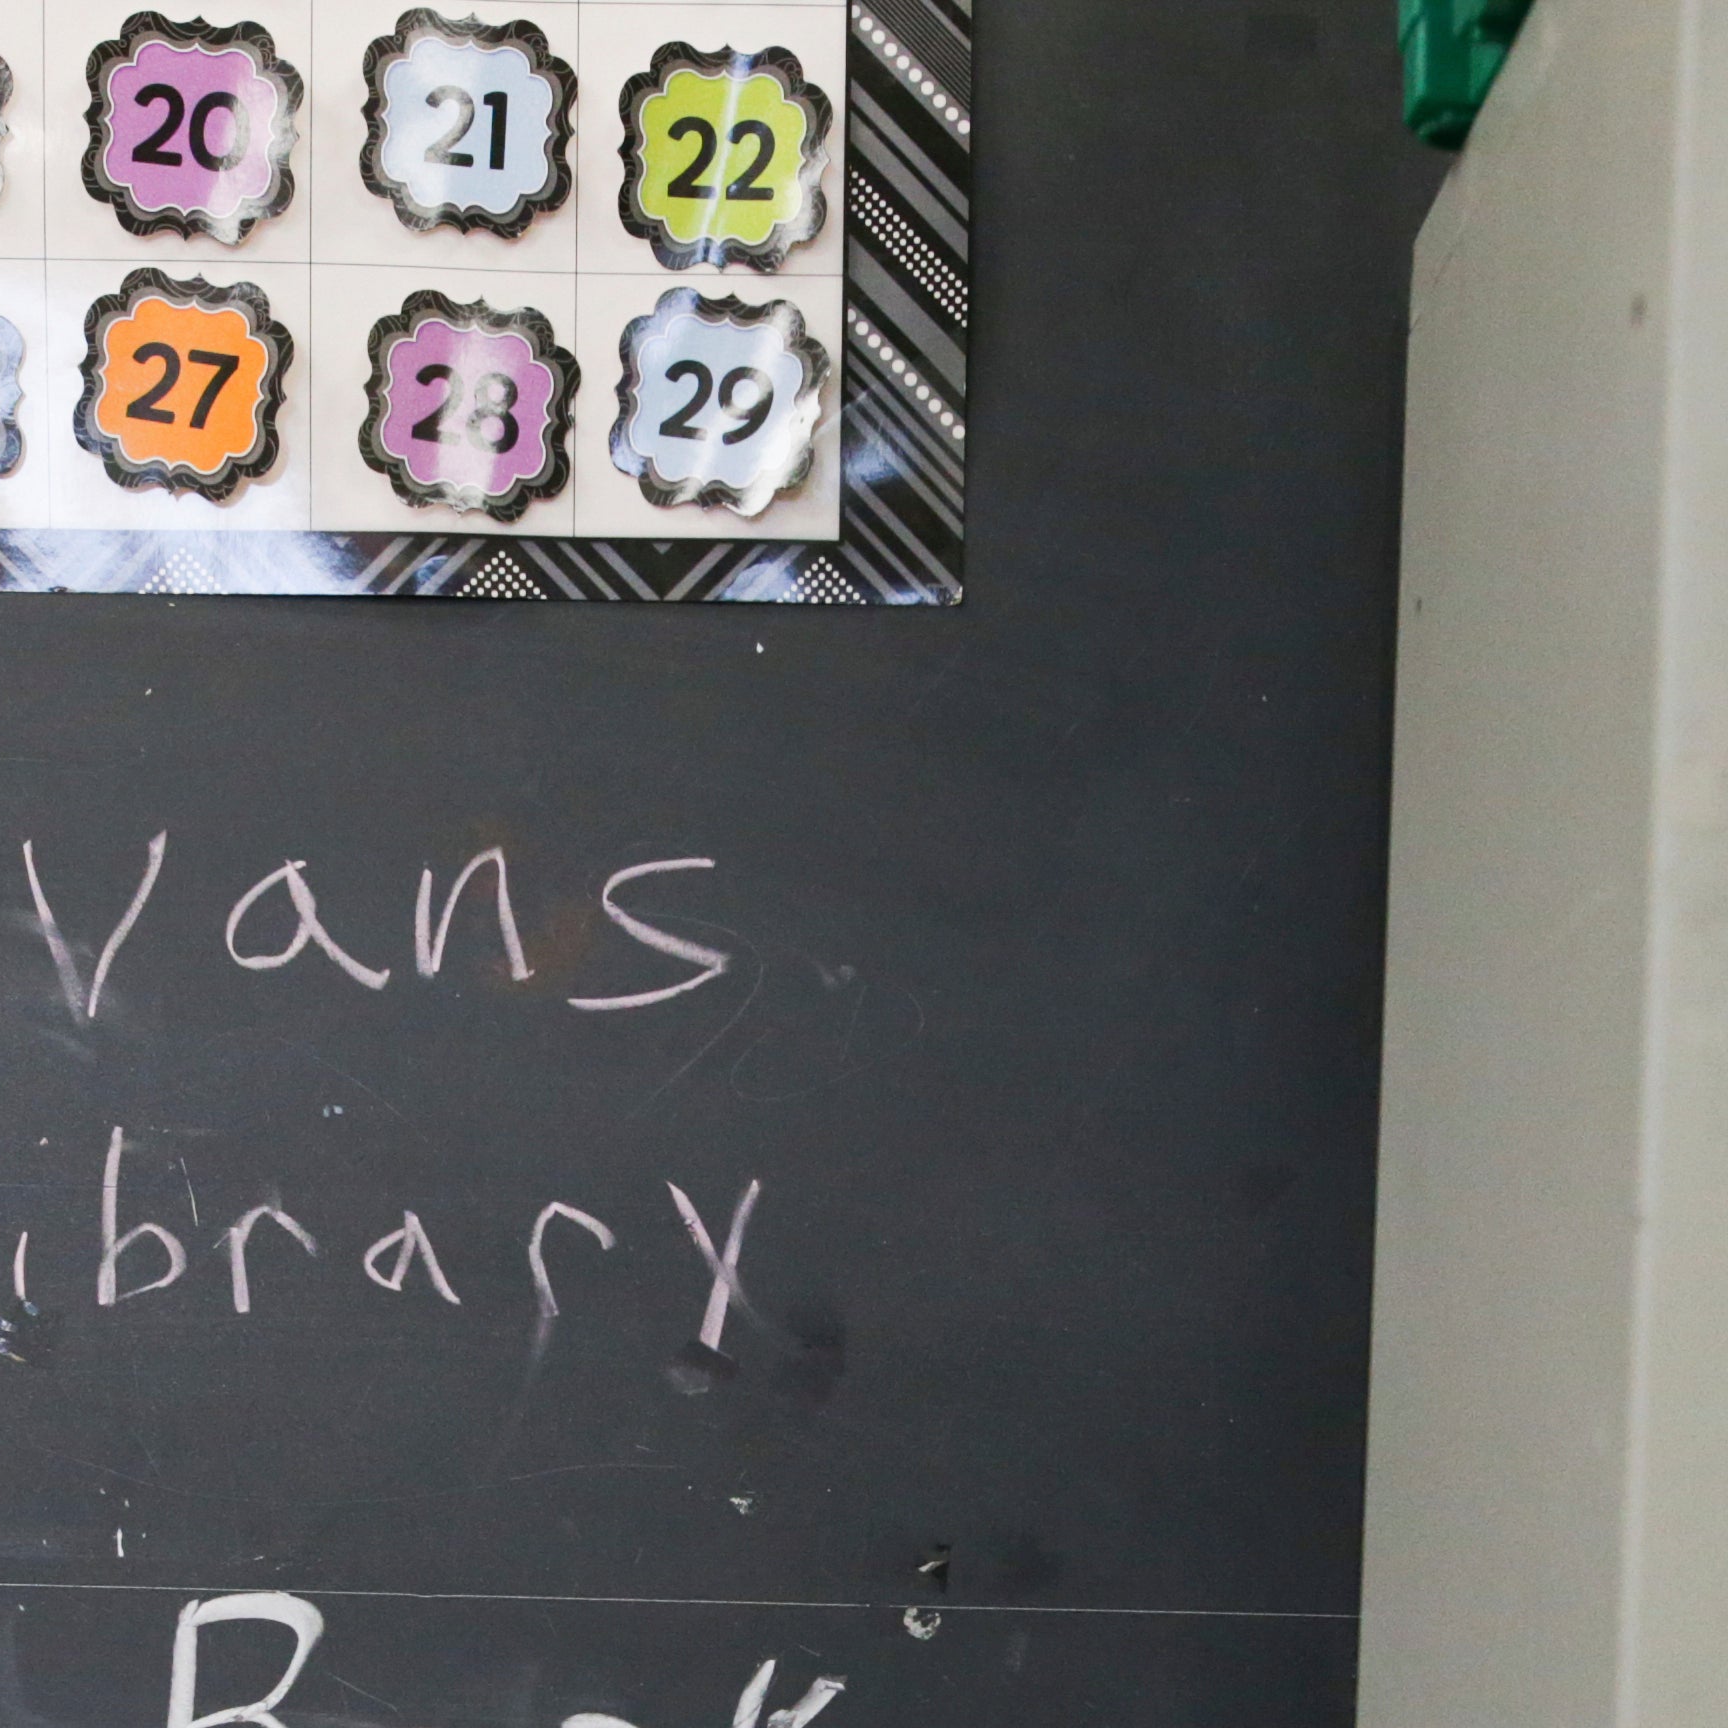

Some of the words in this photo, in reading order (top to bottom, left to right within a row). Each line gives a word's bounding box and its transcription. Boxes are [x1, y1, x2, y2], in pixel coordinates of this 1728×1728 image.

[132, 82, 249, 172] 20
[423, 84, 506, 171] 21
[667, 116, 776, 201] 22
[125, 341, 240, 430] 27
[411, 362, 520, 456] 28
[663, 360, 775, 446] 29
